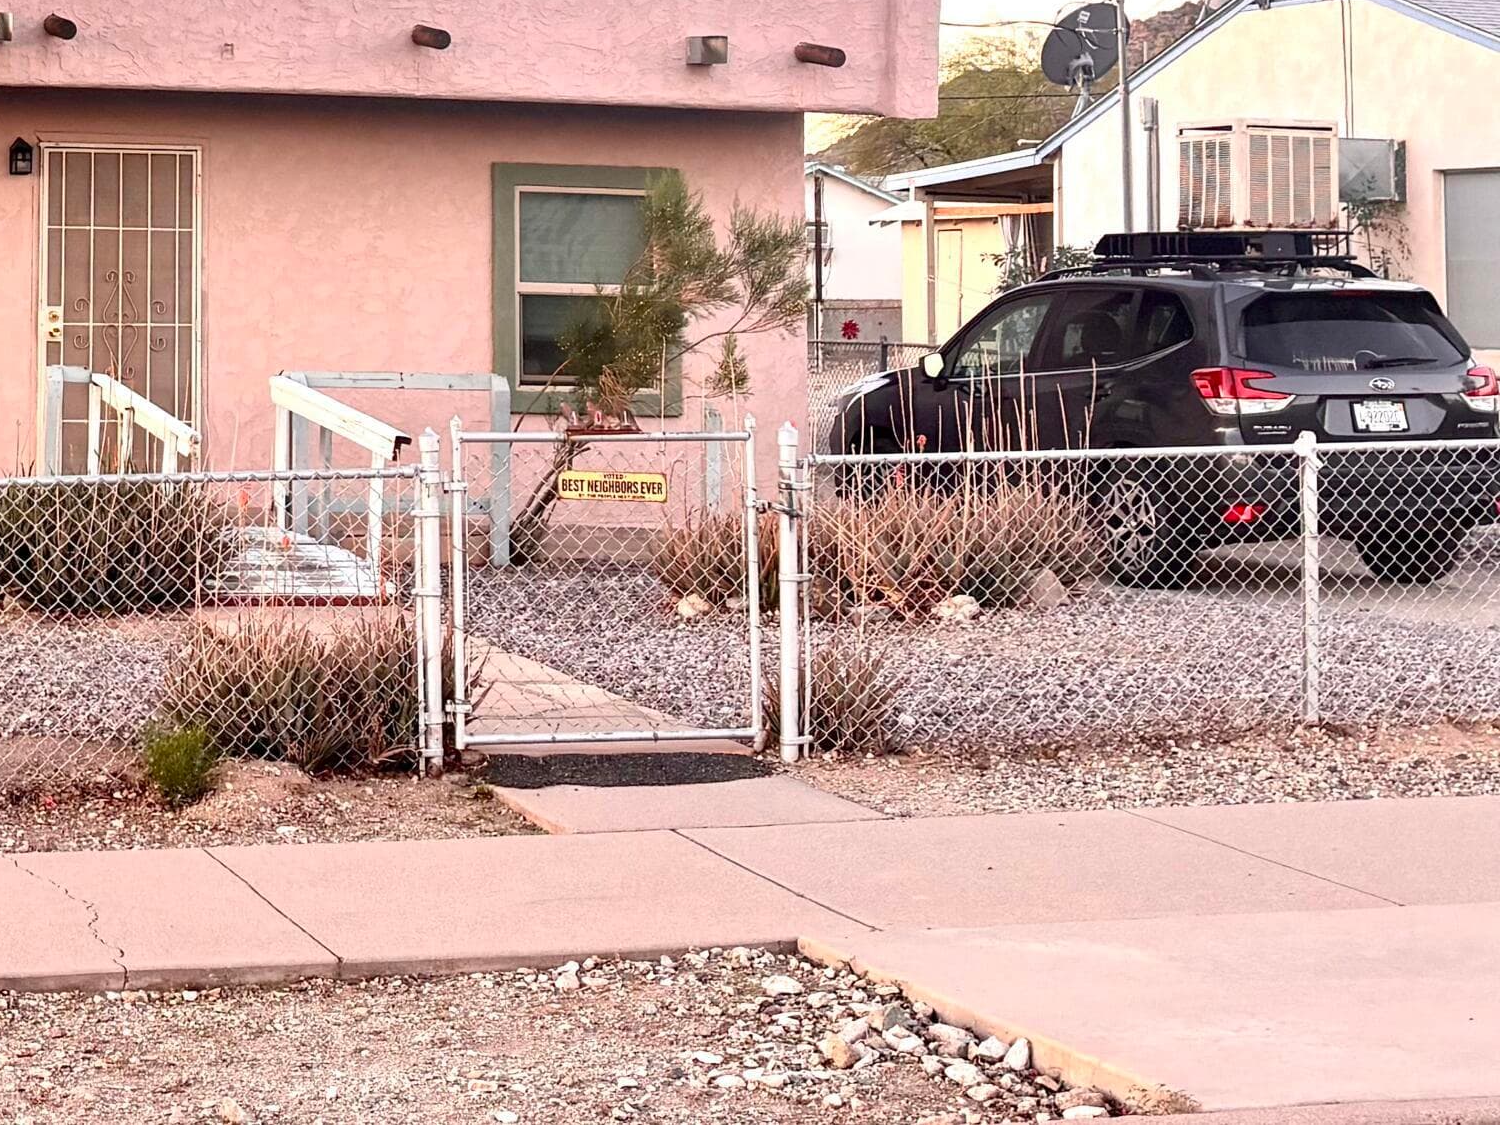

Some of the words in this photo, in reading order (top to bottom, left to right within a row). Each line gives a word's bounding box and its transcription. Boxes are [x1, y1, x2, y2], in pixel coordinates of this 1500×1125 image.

[562, 479, 585, 491] BEST
[587, 480, 639, 494] NEIGHBORS
[641, 482, 663, 495] EVER
